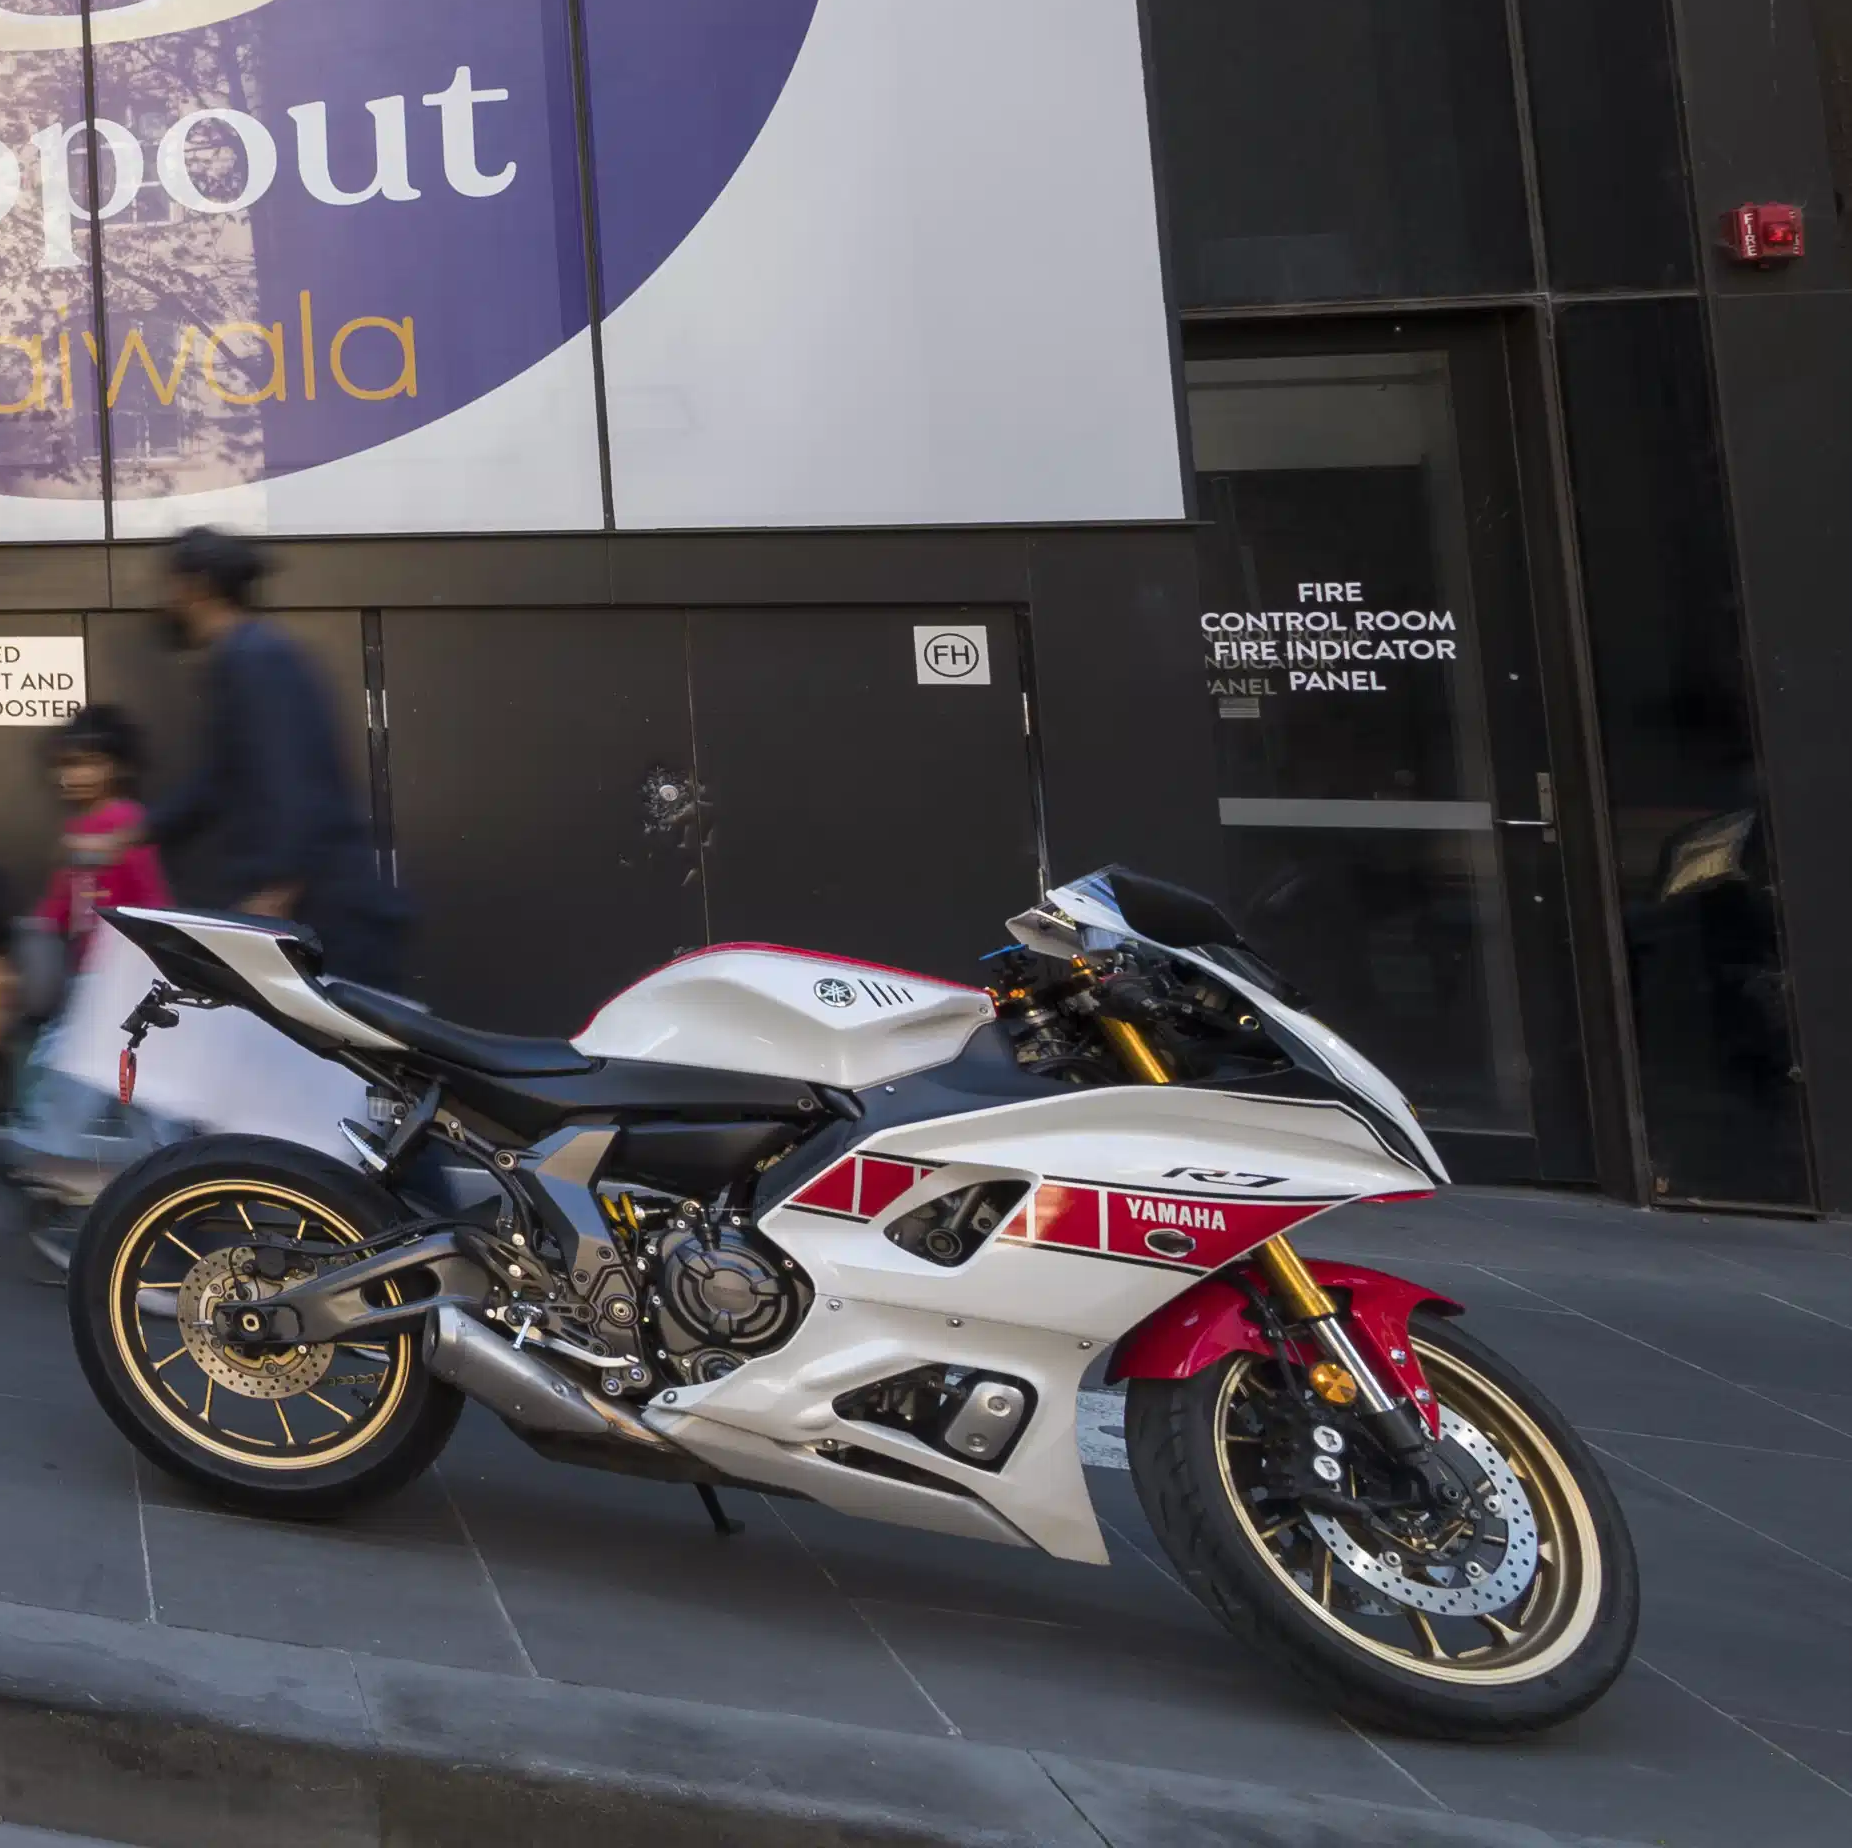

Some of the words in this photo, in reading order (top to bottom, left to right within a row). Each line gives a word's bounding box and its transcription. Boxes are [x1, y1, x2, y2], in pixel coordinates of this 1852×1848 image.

[1744, 213, 1757, 257] FIRE
[1297, 582, 1364, 602] FIRE
[1200, 611, 1347, 632] CONTROL
[1355, 610, 1456, 631] ROOM
[933, 644, 970, 665] FH
[1214, 641, 1277, 660] FIRE
[1286, 640, 1457, 660] INDICATOR
[20, 673, 74, 691] AND
[1289, 670, 1387, 691] PANEL
[1161, 1166, 1291, 1189] R7
[1125, 1197, 1227, 1232] YAMAHA
